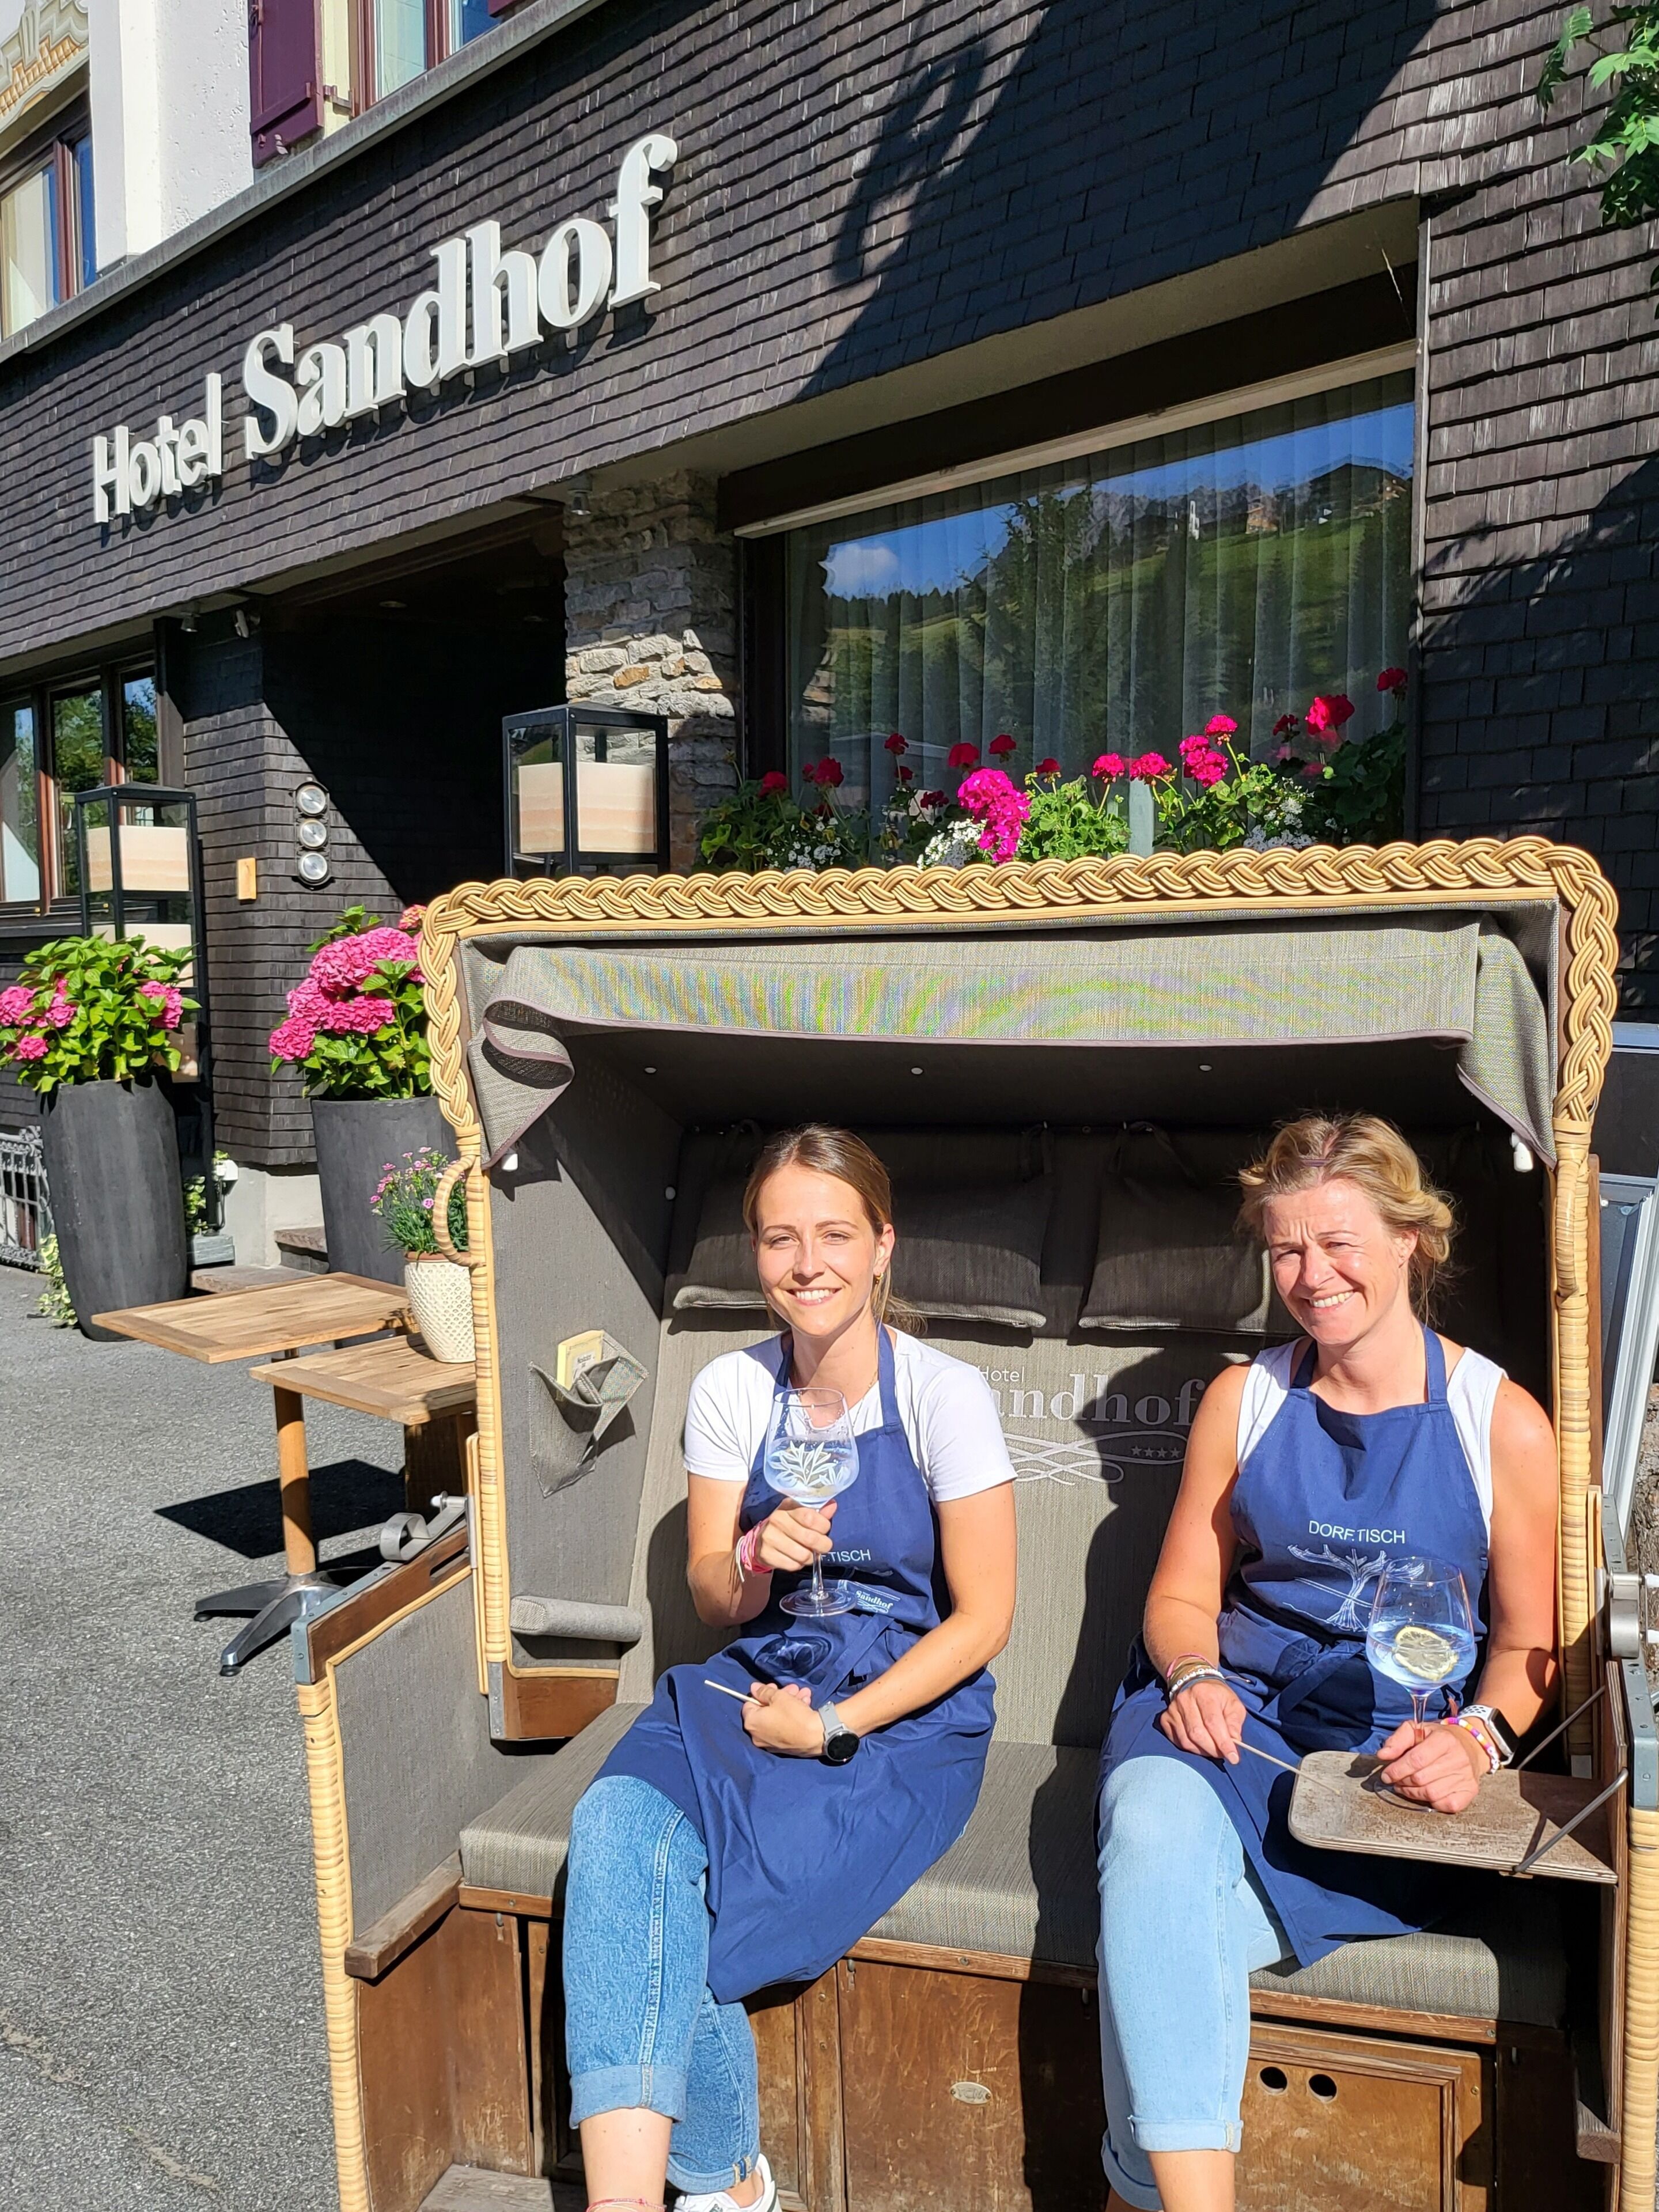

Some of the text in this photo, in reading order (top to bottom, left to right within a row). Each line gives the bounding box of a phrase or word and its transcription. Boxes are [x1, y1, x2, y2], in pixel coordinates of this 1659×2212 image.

[93, 133, 678, 524] Hotel Sandhof
[978, 1365, 1024, 1382] Hotel
[990, 1373, 1205, 1426] ndhof
[1309, 1520, 1405, 1544] DORF.TISCH
[856, 1590, 893, 1609] Sandhof
